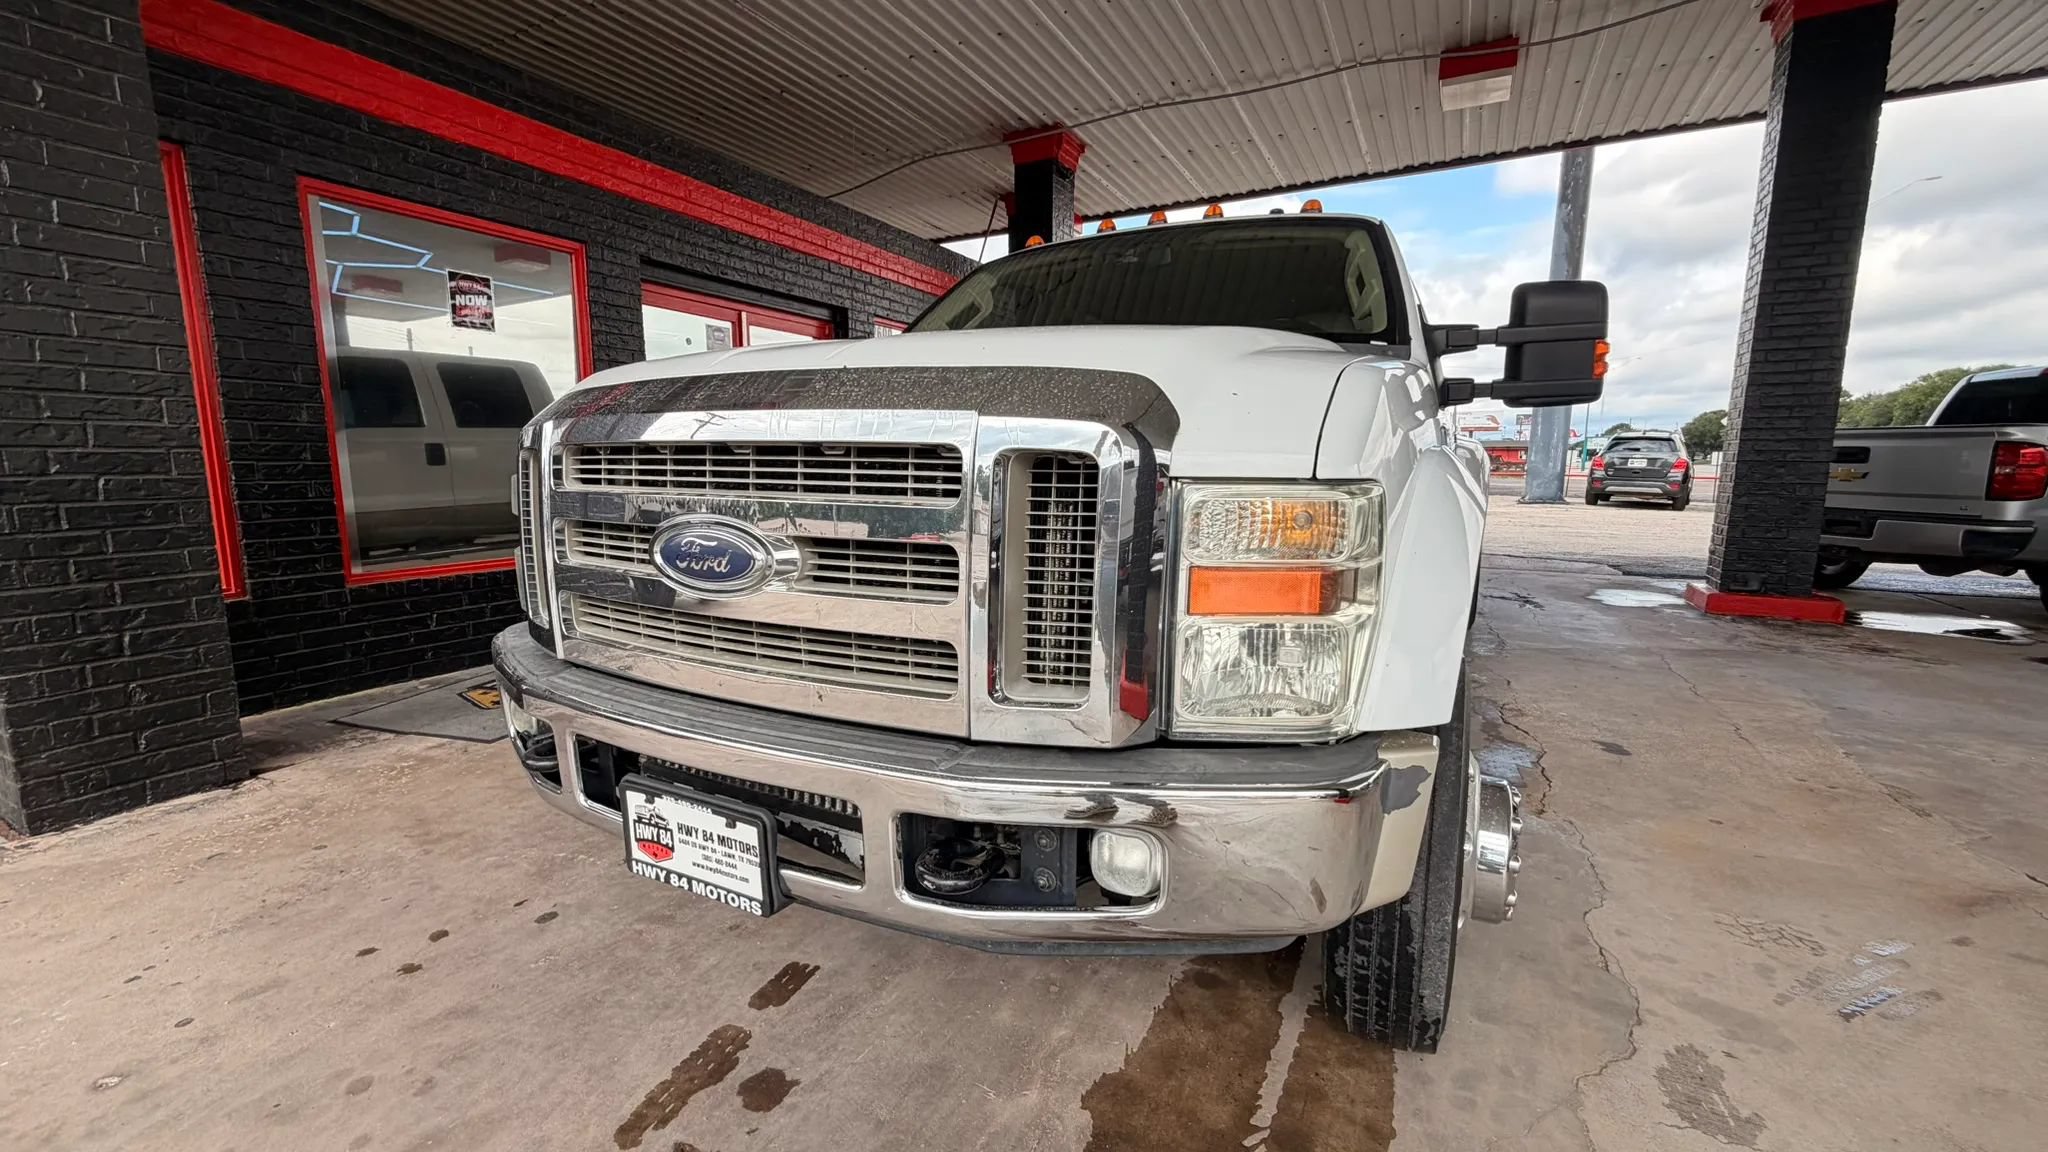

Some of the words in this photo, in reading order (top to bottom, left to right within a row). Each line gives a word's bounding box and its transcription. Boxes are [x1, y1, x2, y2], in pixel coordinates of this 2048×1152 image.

[455, 294, 488, 306] NOW
[675, 537, 732, 573] Ford
[635, 822, 659, 842] HWY
[659, 829, 673, 848] 84
[677, 822, 699, 840] HWY
[702, 829, 715, 844] 84
[717, 833, 759, 858] MOTORS
[632, 860, 667, 882] HWY
[669, 873, 689, 891] 84
[692, 880, 763, 917] MOTORS
